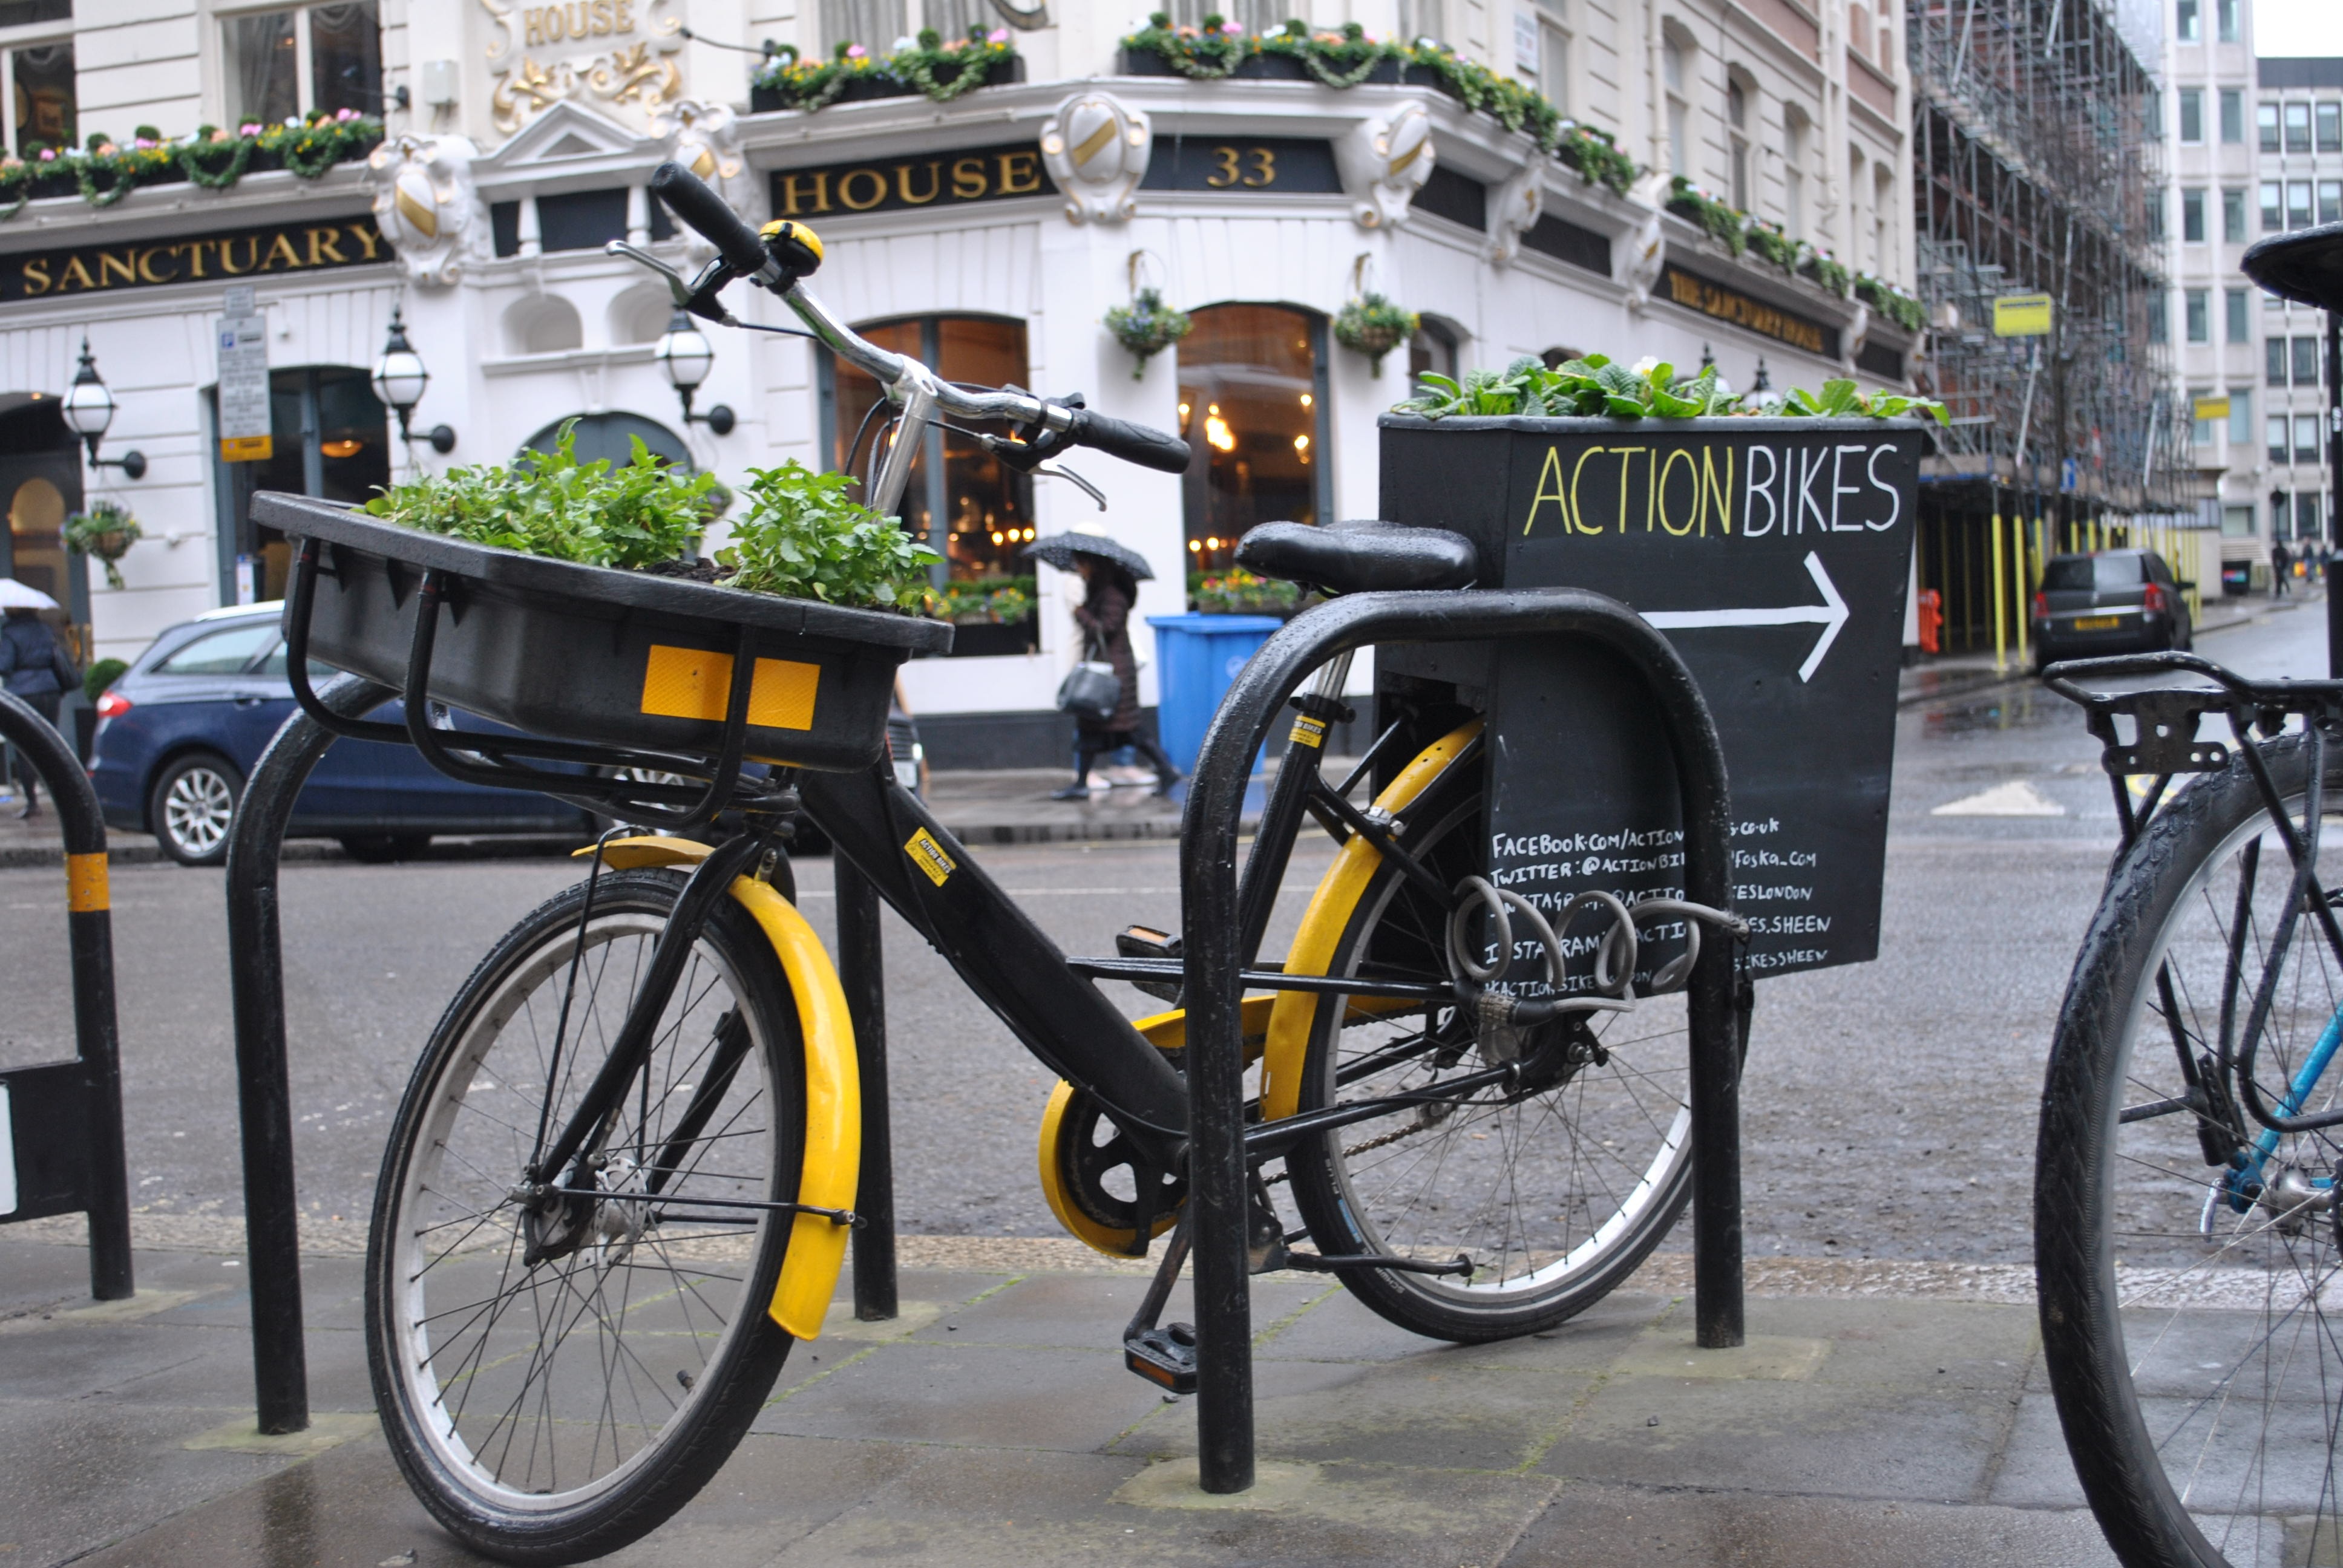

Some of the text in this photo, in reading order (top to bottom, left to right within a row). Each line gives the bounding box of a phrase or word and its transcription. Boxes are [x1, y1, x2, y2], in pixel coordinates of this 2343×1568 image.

[523, 0, 635, 46] HOUSE
[779, 151, 1041, 216] HOUSE
[1207, 146, 1276, 188] 33
[22, 222, 382, 295] SANCTUARY
